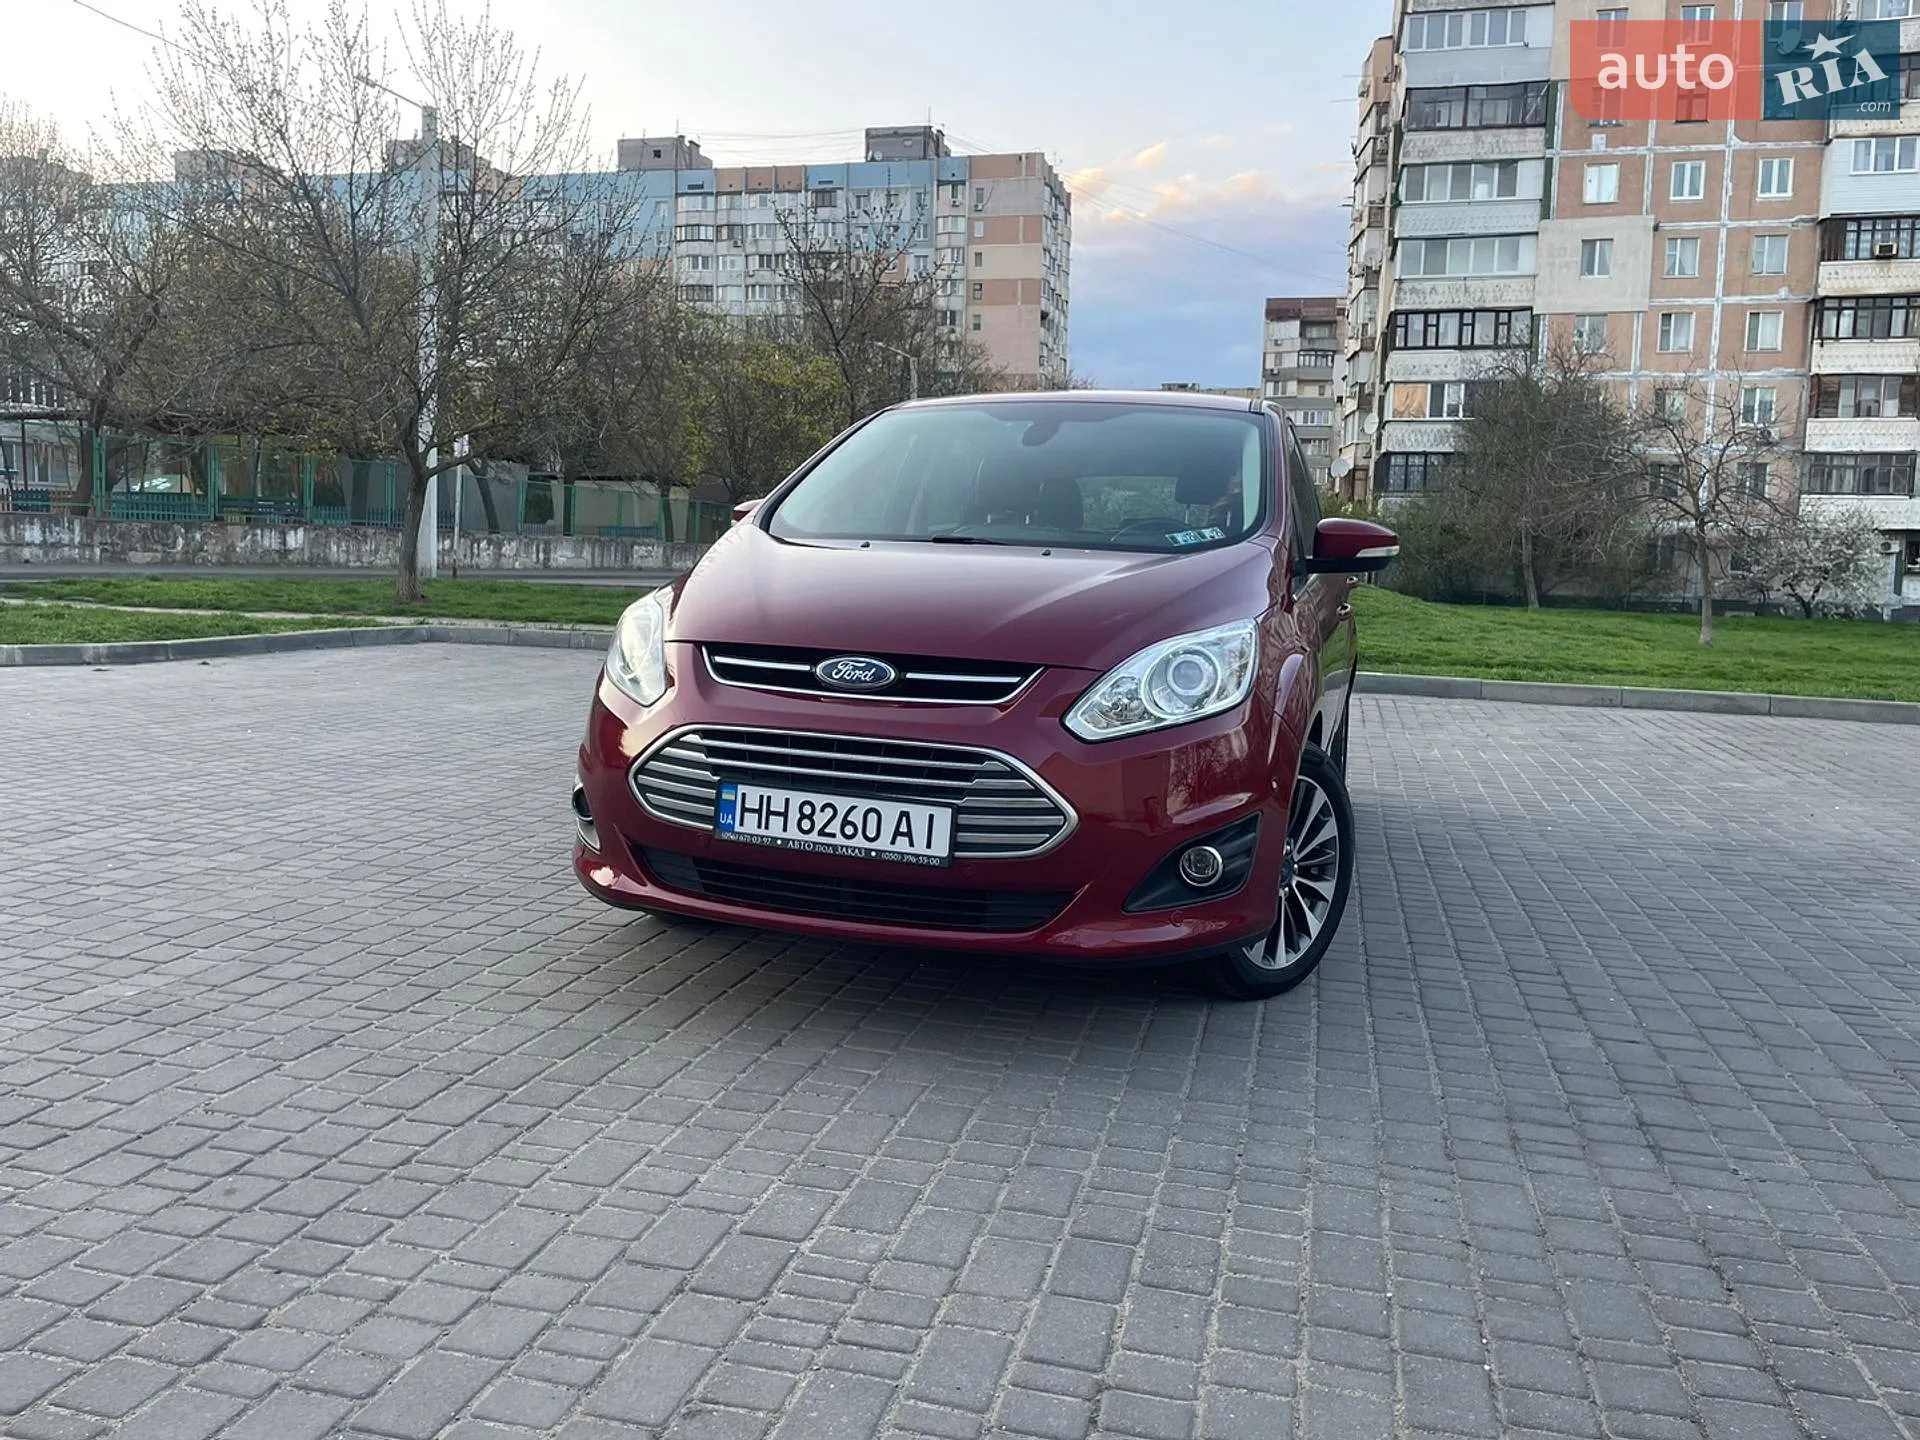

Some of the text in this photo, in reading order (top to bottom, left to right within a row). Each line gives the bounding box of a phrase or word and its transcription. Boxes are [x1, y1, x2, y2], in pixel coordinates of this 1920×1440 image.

[832, 660, 876, 682] Ford
[719, 812, 734, 825] UA
[739, 792, 935, 850] HH 8260 AI
[787, 840, 813, 852] АВТО
[836, 846, 865, 857] ЗАКАЗ
